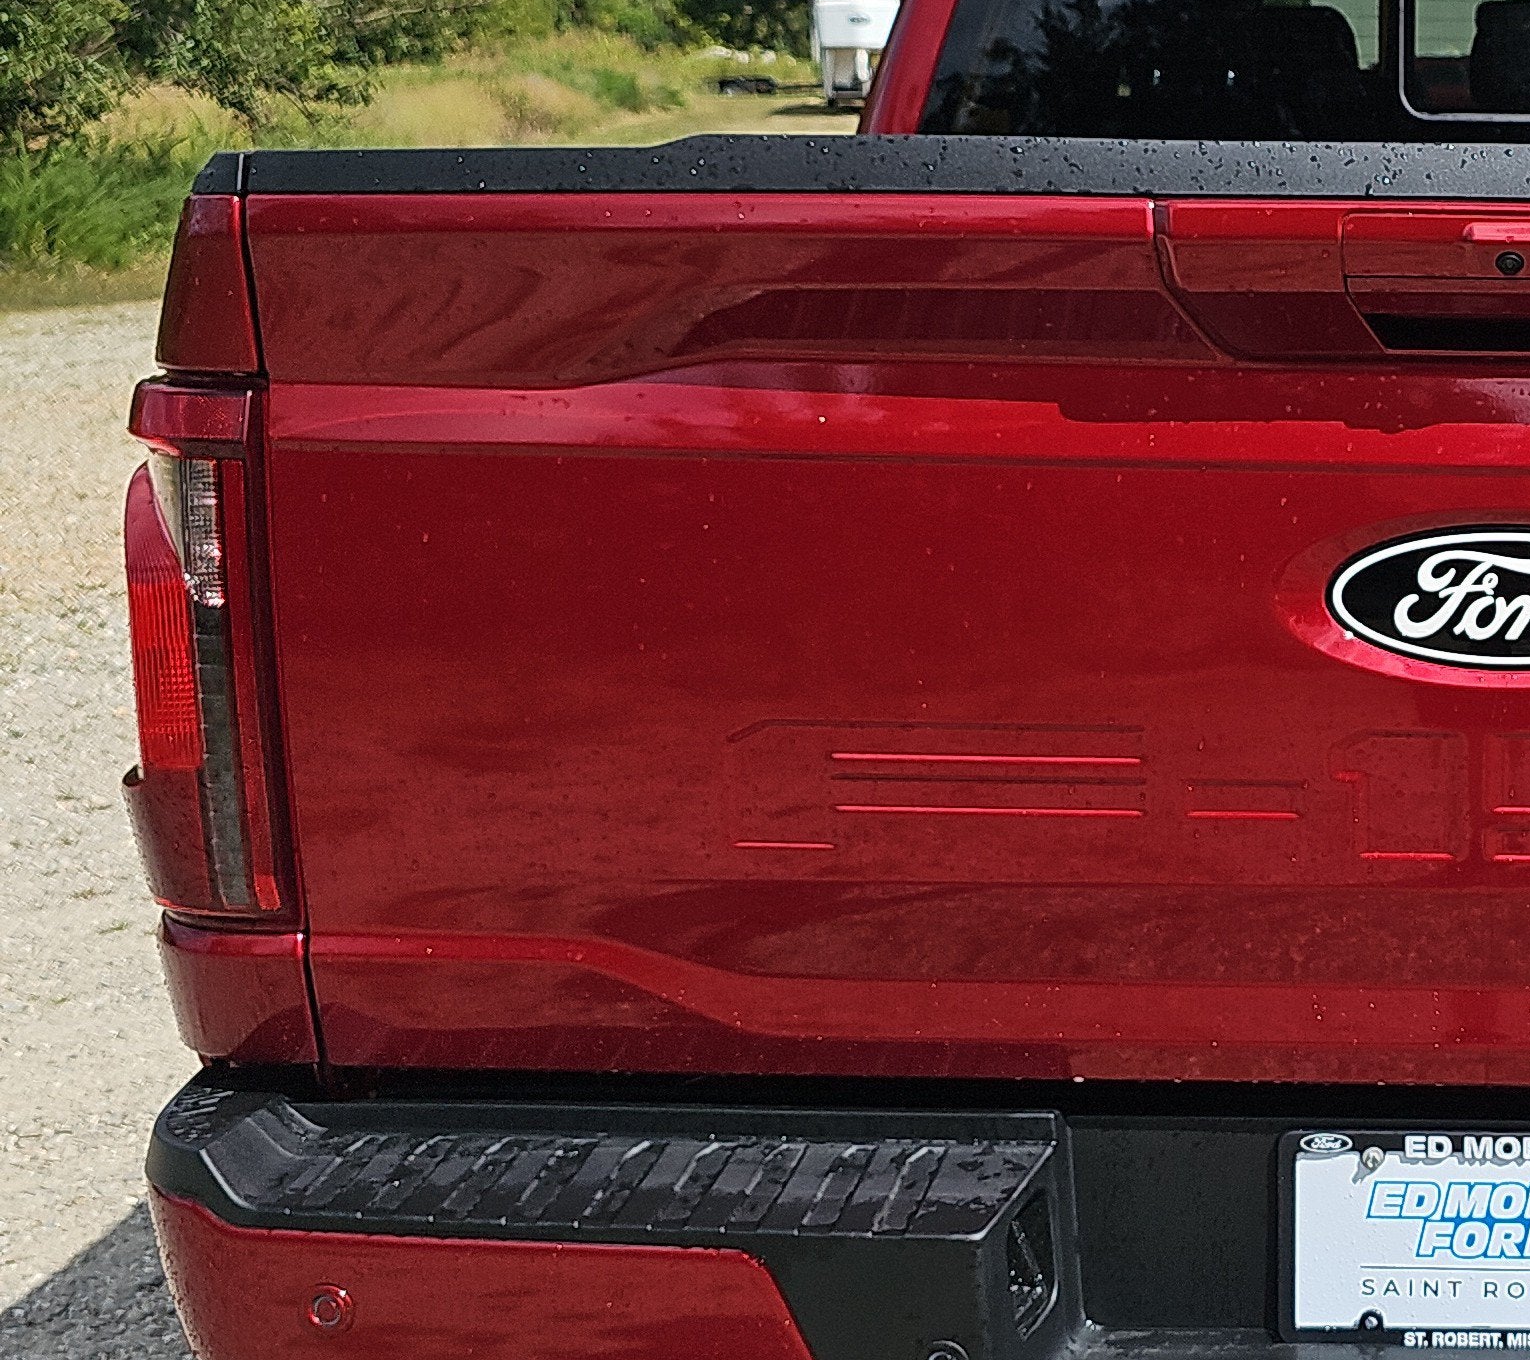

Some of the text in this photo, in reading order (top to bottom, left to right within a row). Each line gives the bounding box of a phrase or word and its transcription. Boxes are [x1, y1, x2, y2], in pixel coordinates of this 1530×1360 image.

[1310, 1135, 1343, 1150] Ford
[1404, 1135, 1453, 1159] ED
[1366, 1180, 1442, 1220] ED
[1360, 1278, 1463, 1298] SAINT
[1403, 1331, 1429, 1348] ST.
[1431, 1331, 1504, 1350] ROBERT,
